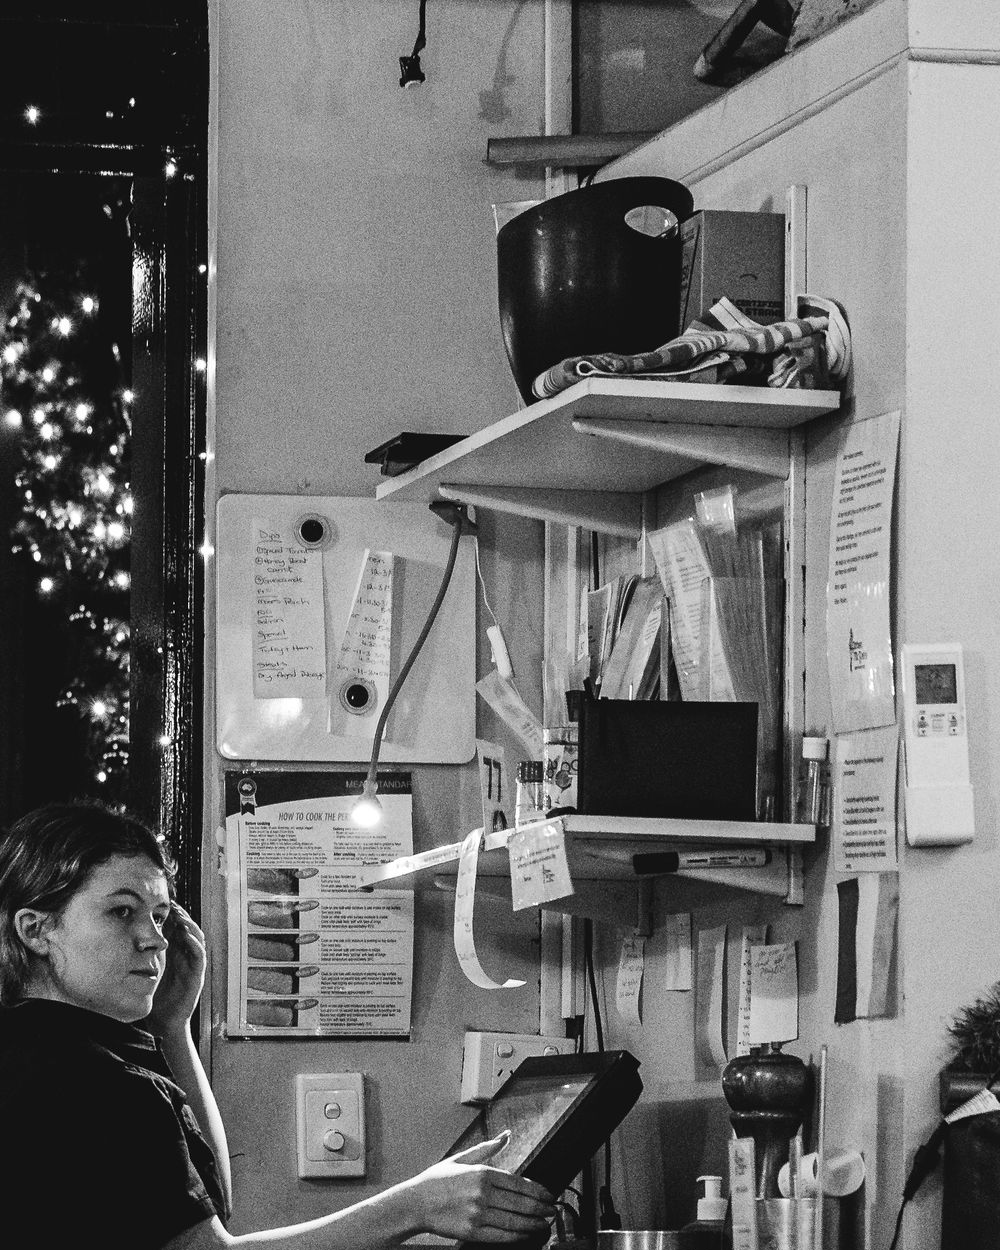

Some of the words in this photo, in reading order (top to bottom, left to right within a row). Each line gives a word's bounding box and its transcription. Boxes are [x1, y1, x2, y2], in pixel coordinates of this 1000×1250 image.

[279, 812, 294, 821] HOW
[295, 812, 304, 821] TO
[305, 812, 323, 821] COOK
[325, 812, 336, 821] THE
